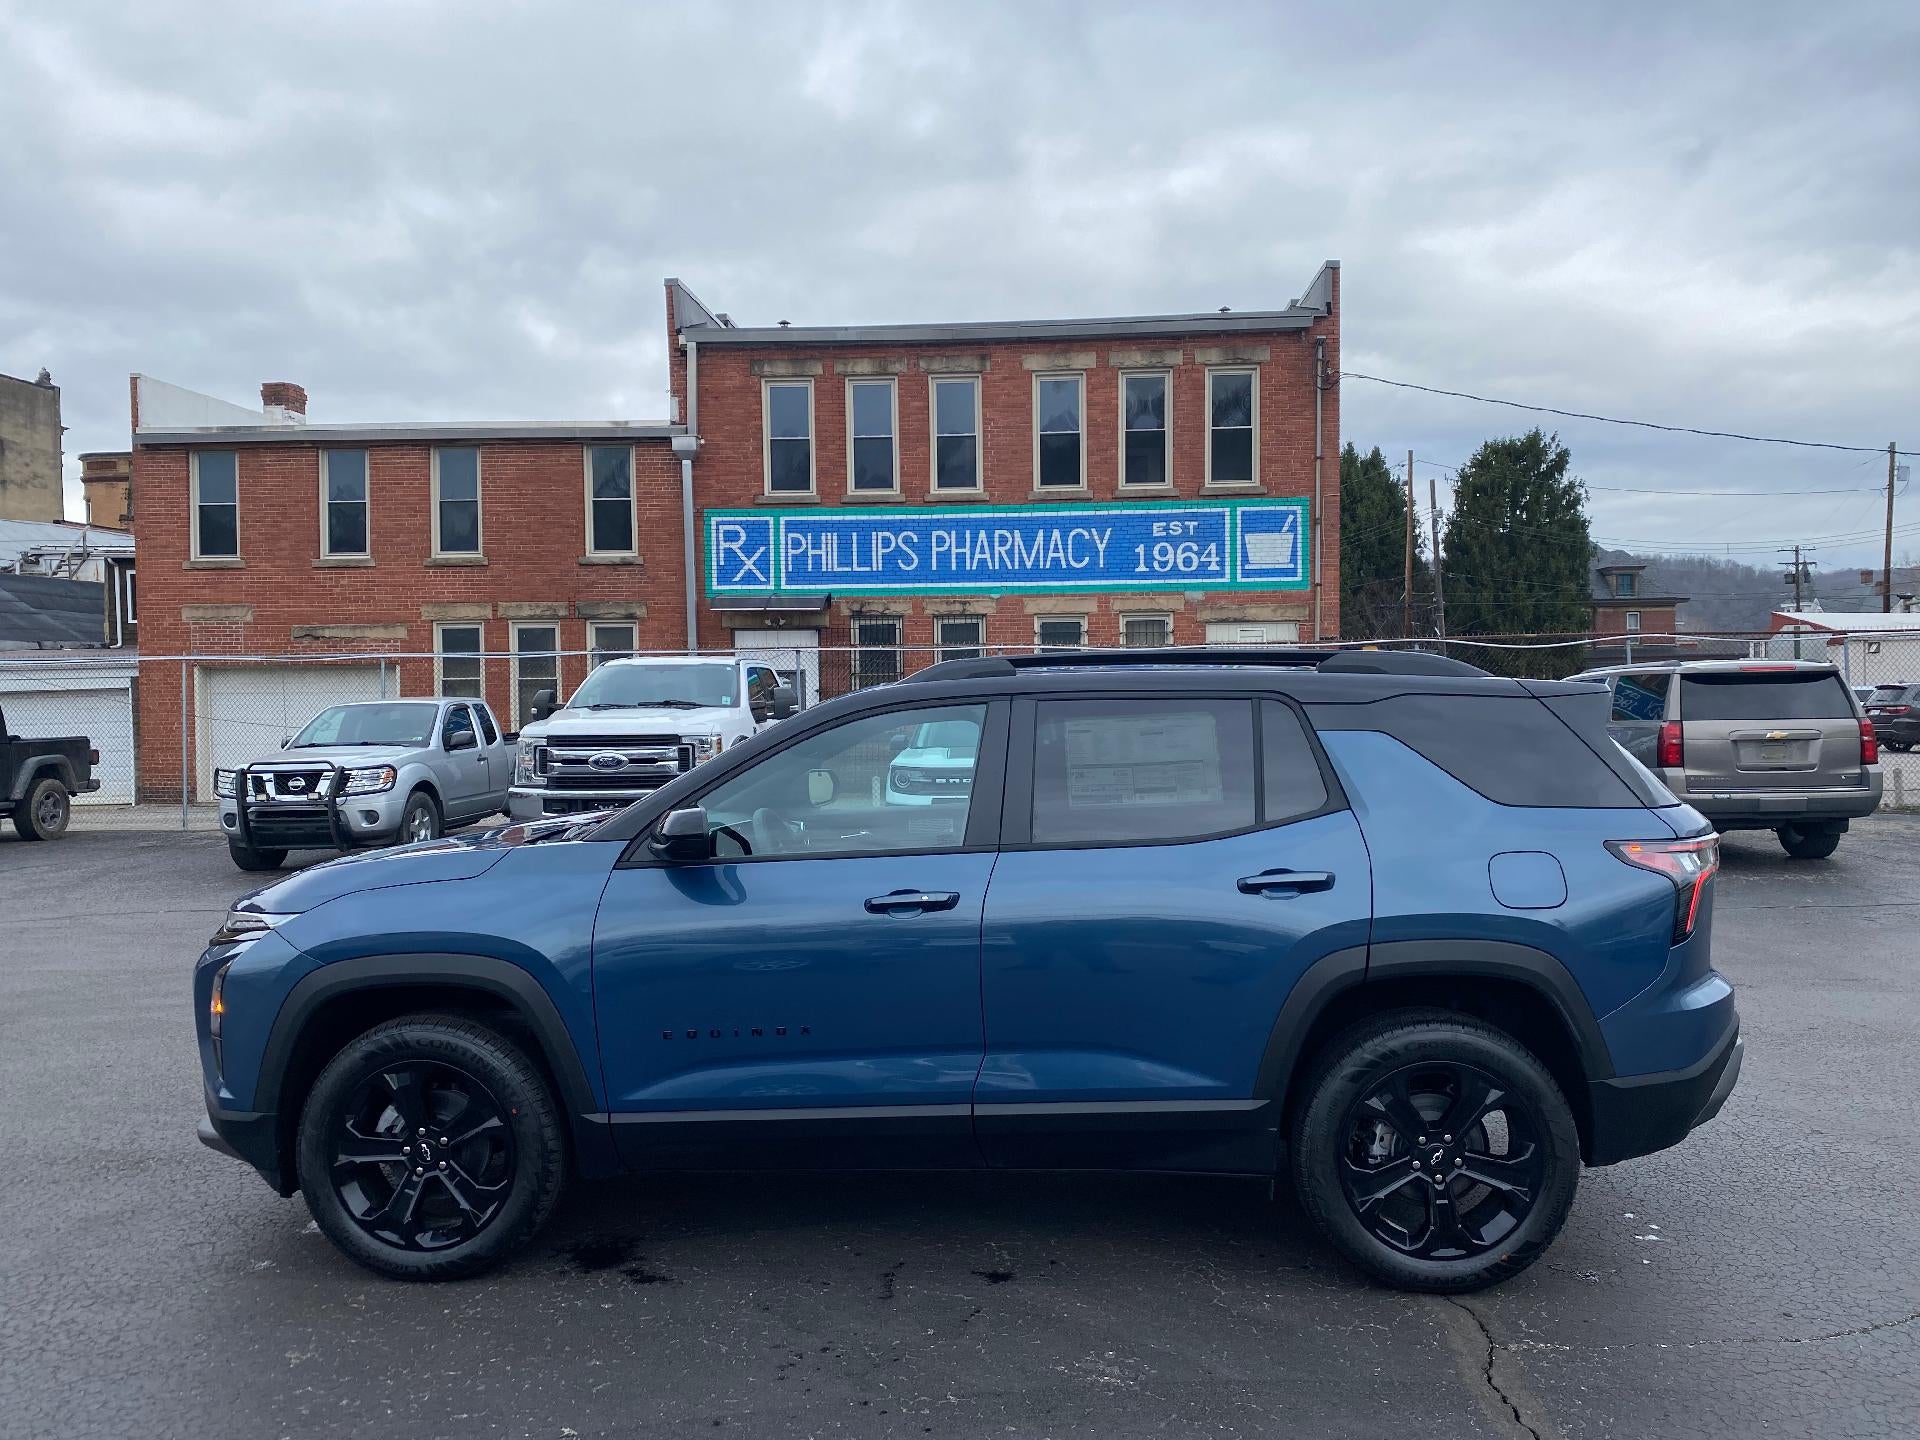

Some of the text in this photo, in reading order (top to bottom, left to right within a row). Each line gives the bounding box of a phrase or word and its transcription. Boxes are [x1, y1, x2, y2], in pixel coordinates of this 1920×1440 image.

[1152, 520, 1199, 537] EST
[787, 527, 1112, 572] PHILLIPS PHARMACY
[1135, 541, 1221, 573] 1964
[662, 1025, 811, 1040] EQUINOX
